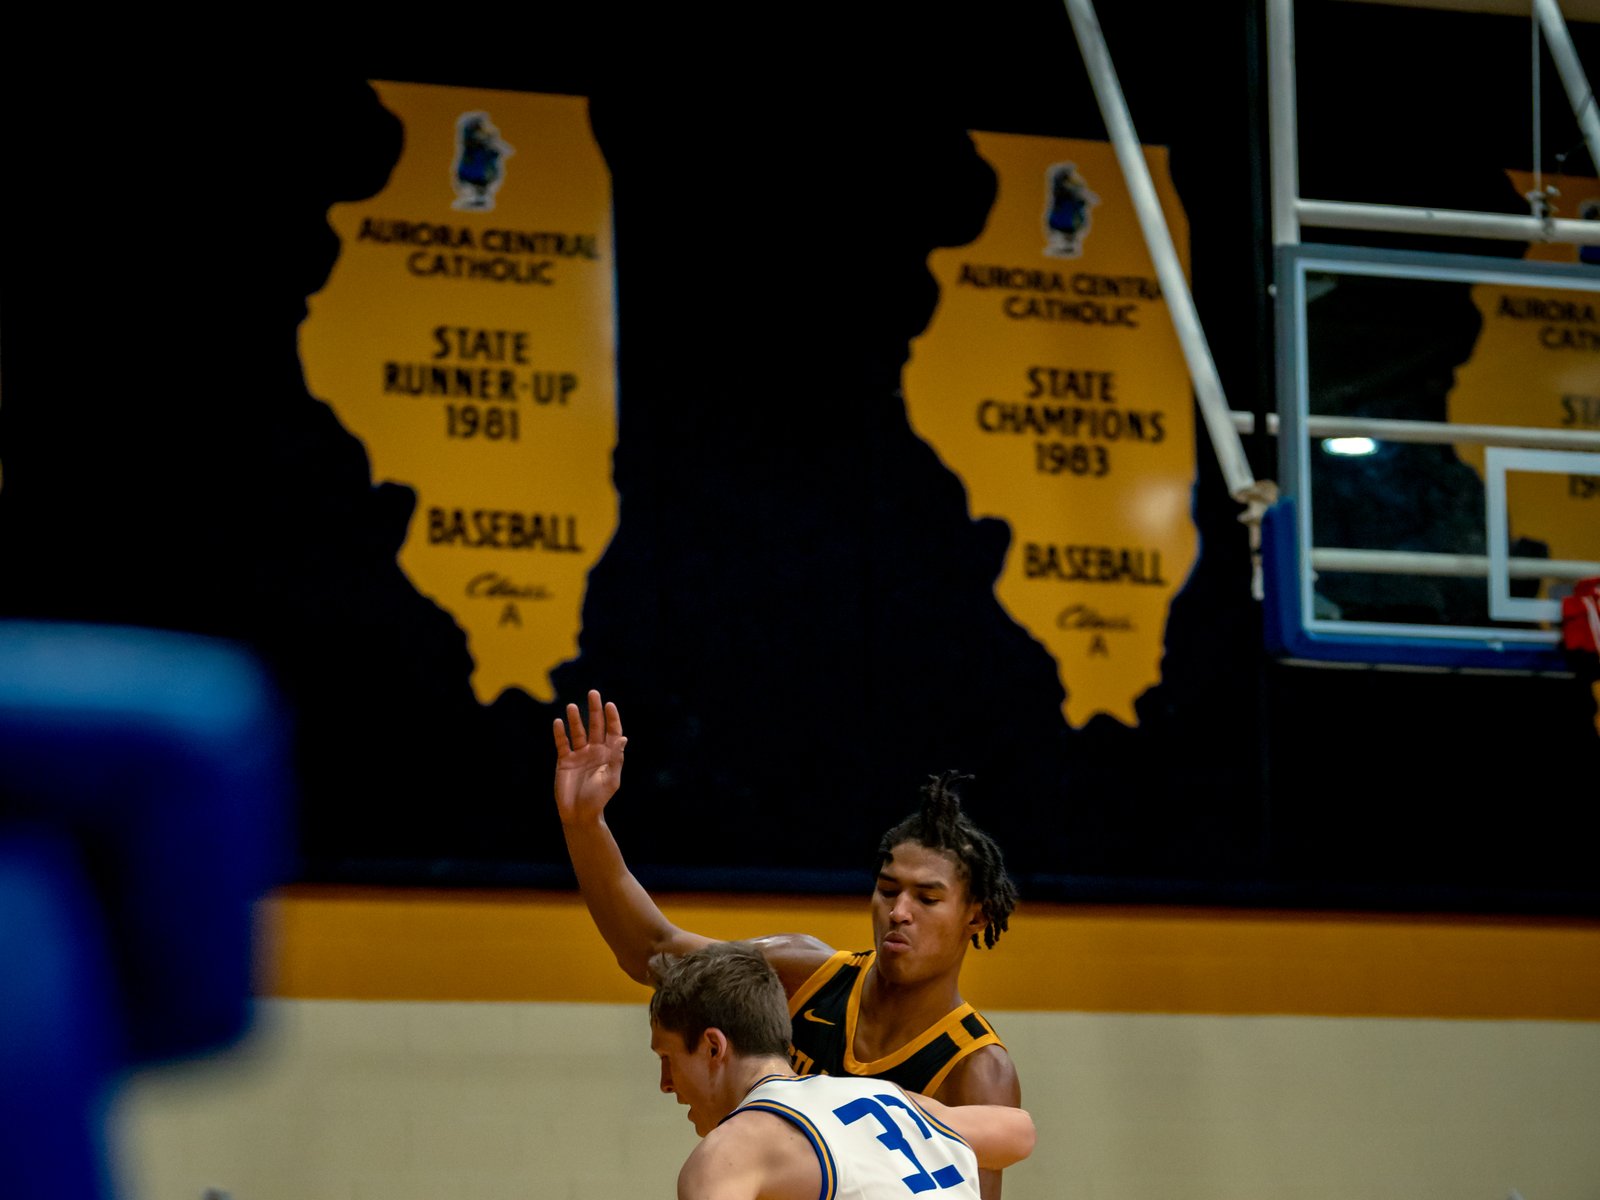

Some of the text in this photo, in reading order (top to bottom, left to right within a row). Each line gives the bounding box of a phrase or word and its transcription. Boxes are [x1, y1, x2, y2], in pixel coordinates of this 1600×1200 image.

[357, 216, 599, 259] AURORA CENTRAL
[406, 250, 555, 286] CATHOLIC
[957, 263, 1066, 294] AURORA
[1004, 295, 1138, 329] CATHOLIC
[1499, 295, 1596, 323] AURORA
[432, 325, 530, 365] STATE
[383, 360, 578, 405] RUNNER-UP
[1026, 366, 1114, 403] STATE
[445, 405, 520, 442] 1981
[977, 399, 1166, 443] CHAMPIONS
[1035, 441, 1110, 477] 1983
[427, 506, 583, 554] BASEBALL
[1024, 542, 1167, 587] BASEBALL
[499, 603, 523, 629] A
[1087, 634, 1109, 658] A
